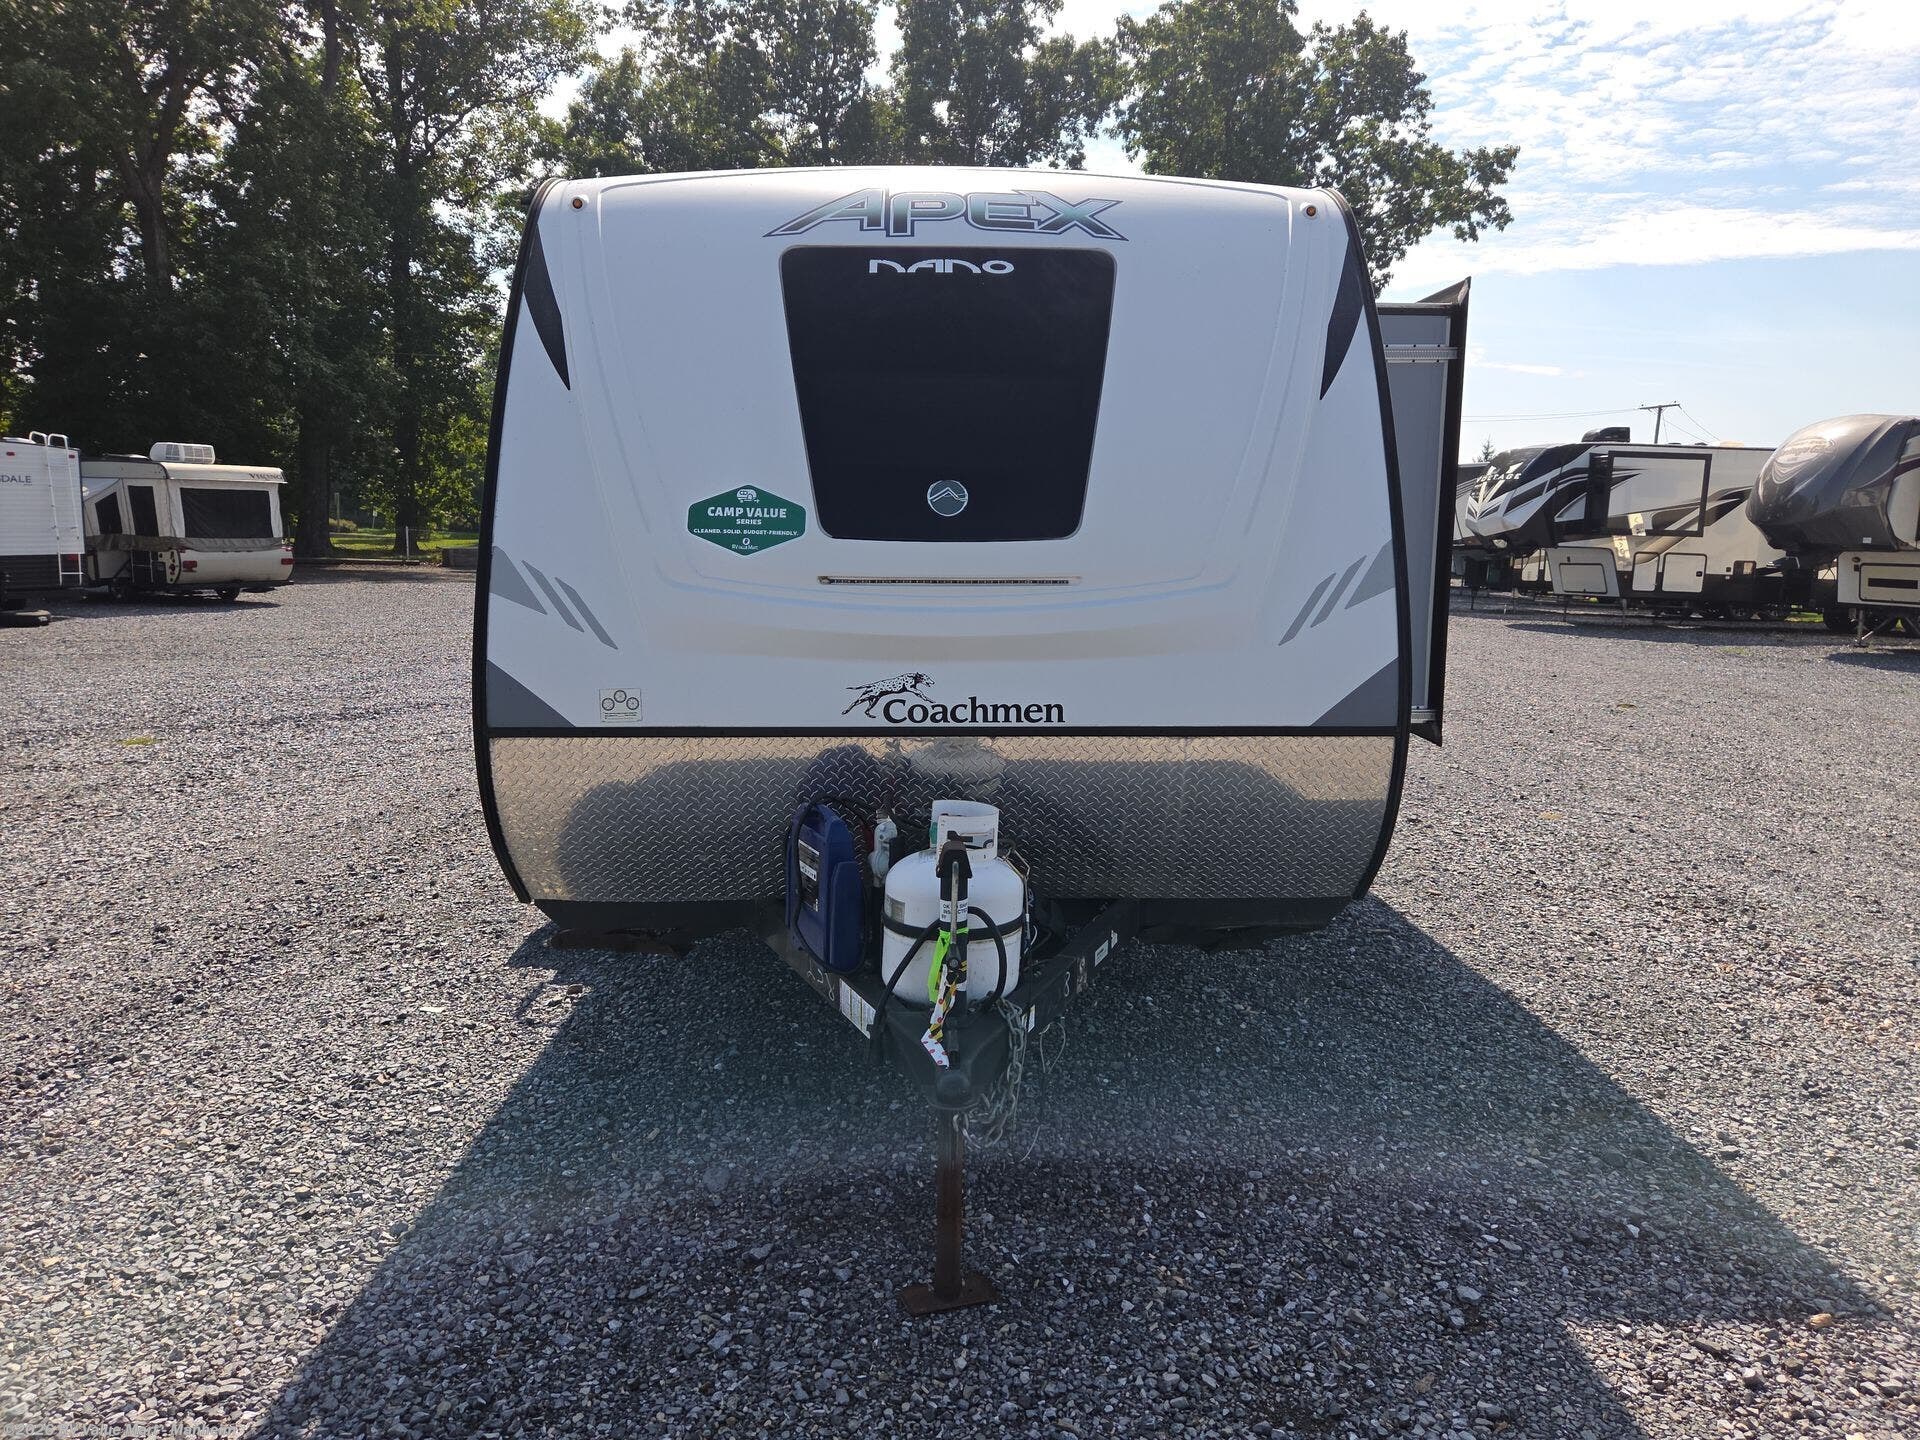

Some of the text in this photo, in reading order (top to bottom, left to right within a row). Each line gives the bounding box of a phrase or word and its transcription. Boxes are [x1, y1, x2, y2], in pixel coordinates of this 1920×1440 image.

[762, 188, 1129, 241] APEX
[0, 474, 32, 483] DALE
[1476, 473, 1522, 483] VOLTAGE
[707, 506, 787, 518] CAMP VALUE
[883, 696, 1065, 724] Coachmen
